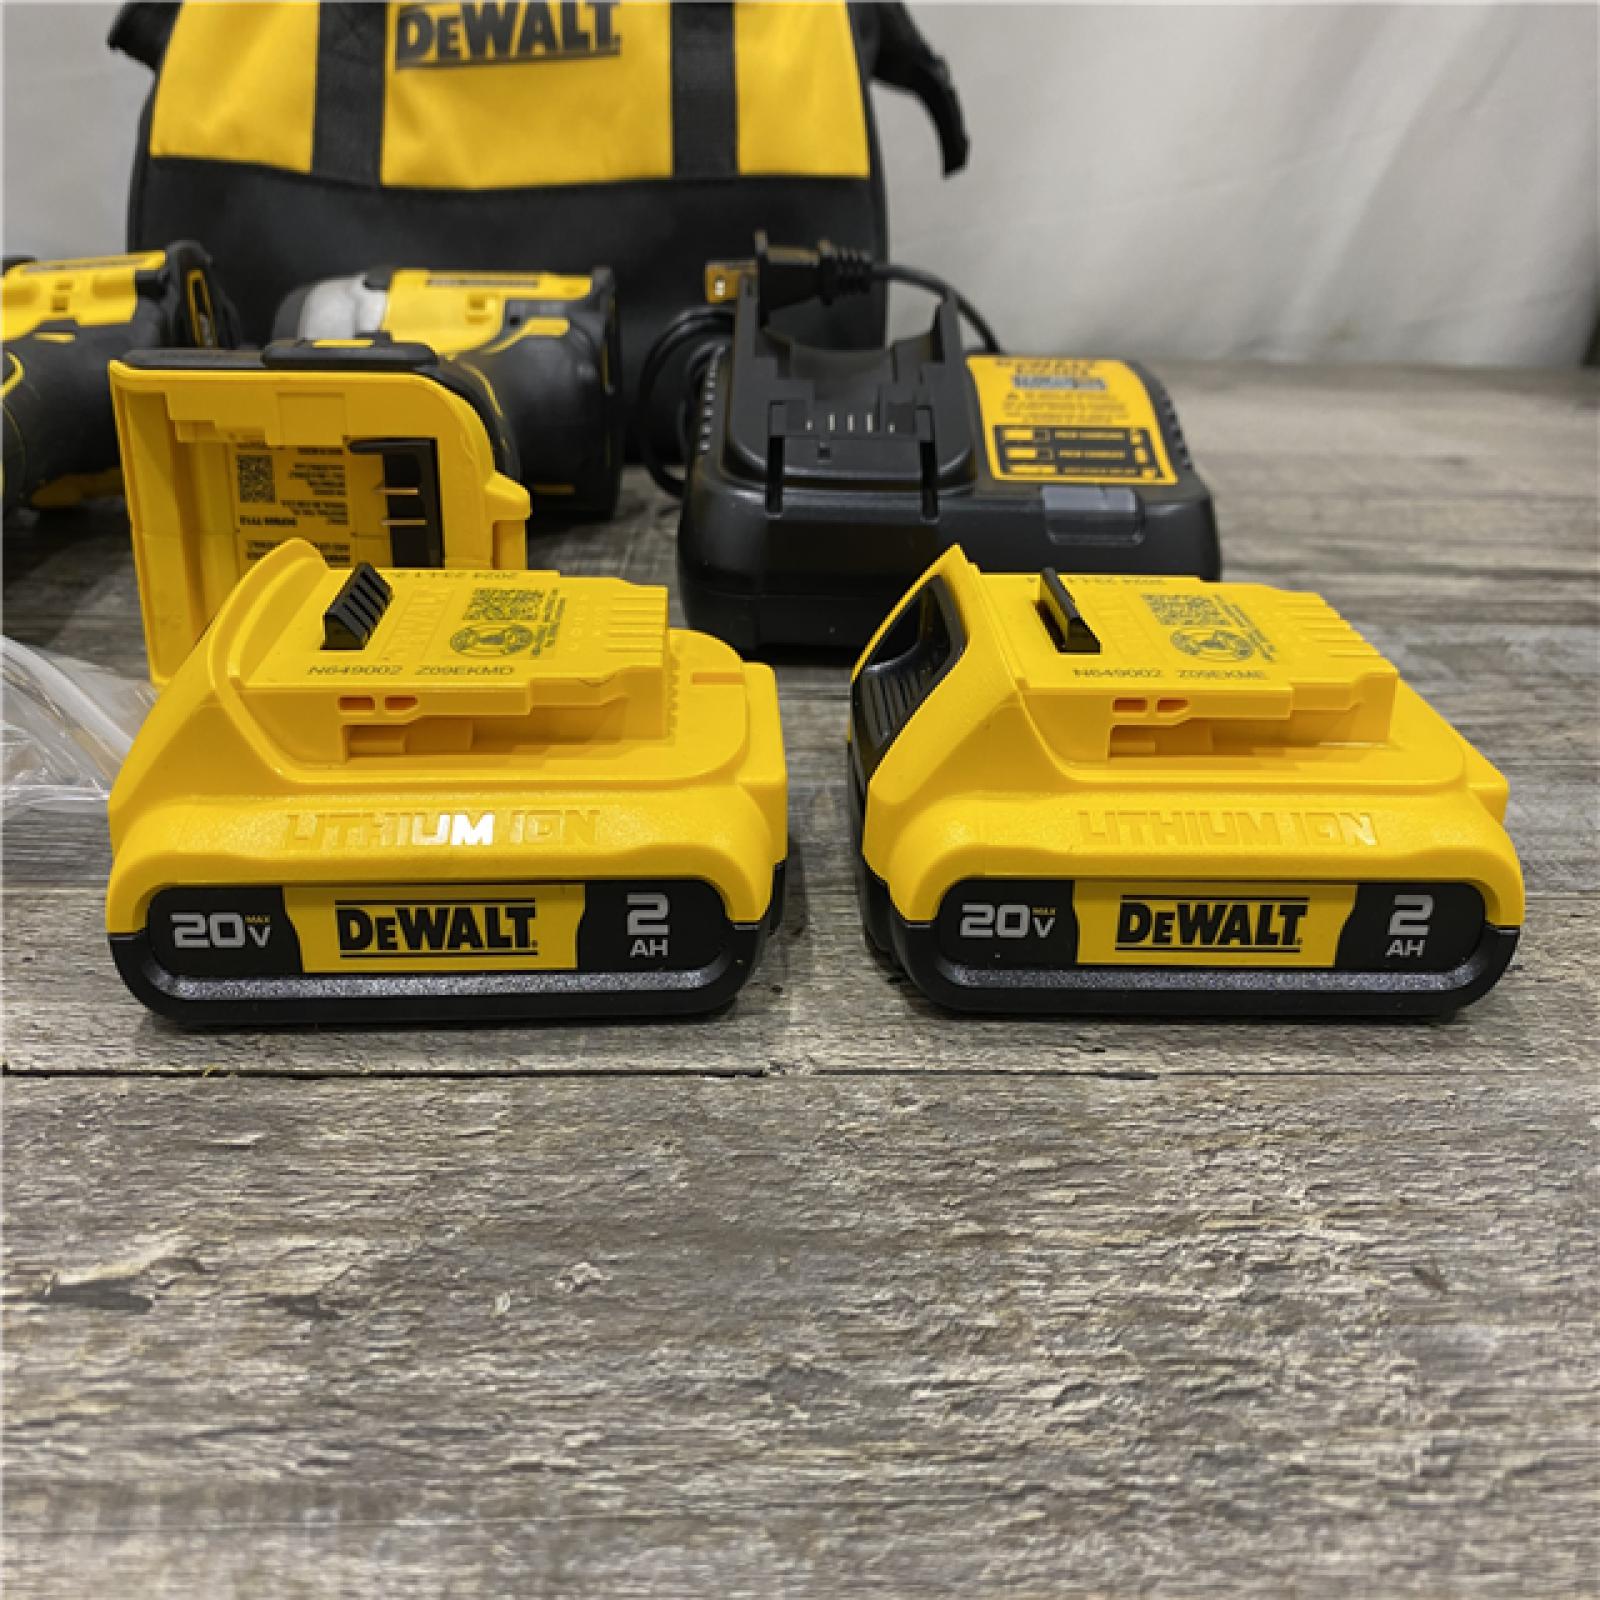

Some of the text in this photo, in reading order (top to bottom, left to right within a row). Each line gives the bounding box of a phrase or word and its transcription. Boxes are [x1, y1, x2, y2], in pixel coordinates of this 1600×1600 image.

[286, 809, 600, 846] LITHIUM ION
[1077, 811, 1377, 846] LITHIUM ION
[335, 906, 538, 951] DEWALT
[626, 893, 671, 936] 2
[1116, 902, 1309, 946] DEWALT
[1387, 894, 1435, 936] 2
[629, 939, 669, 958] AH
[1384, 939, 1427, 959] AH
